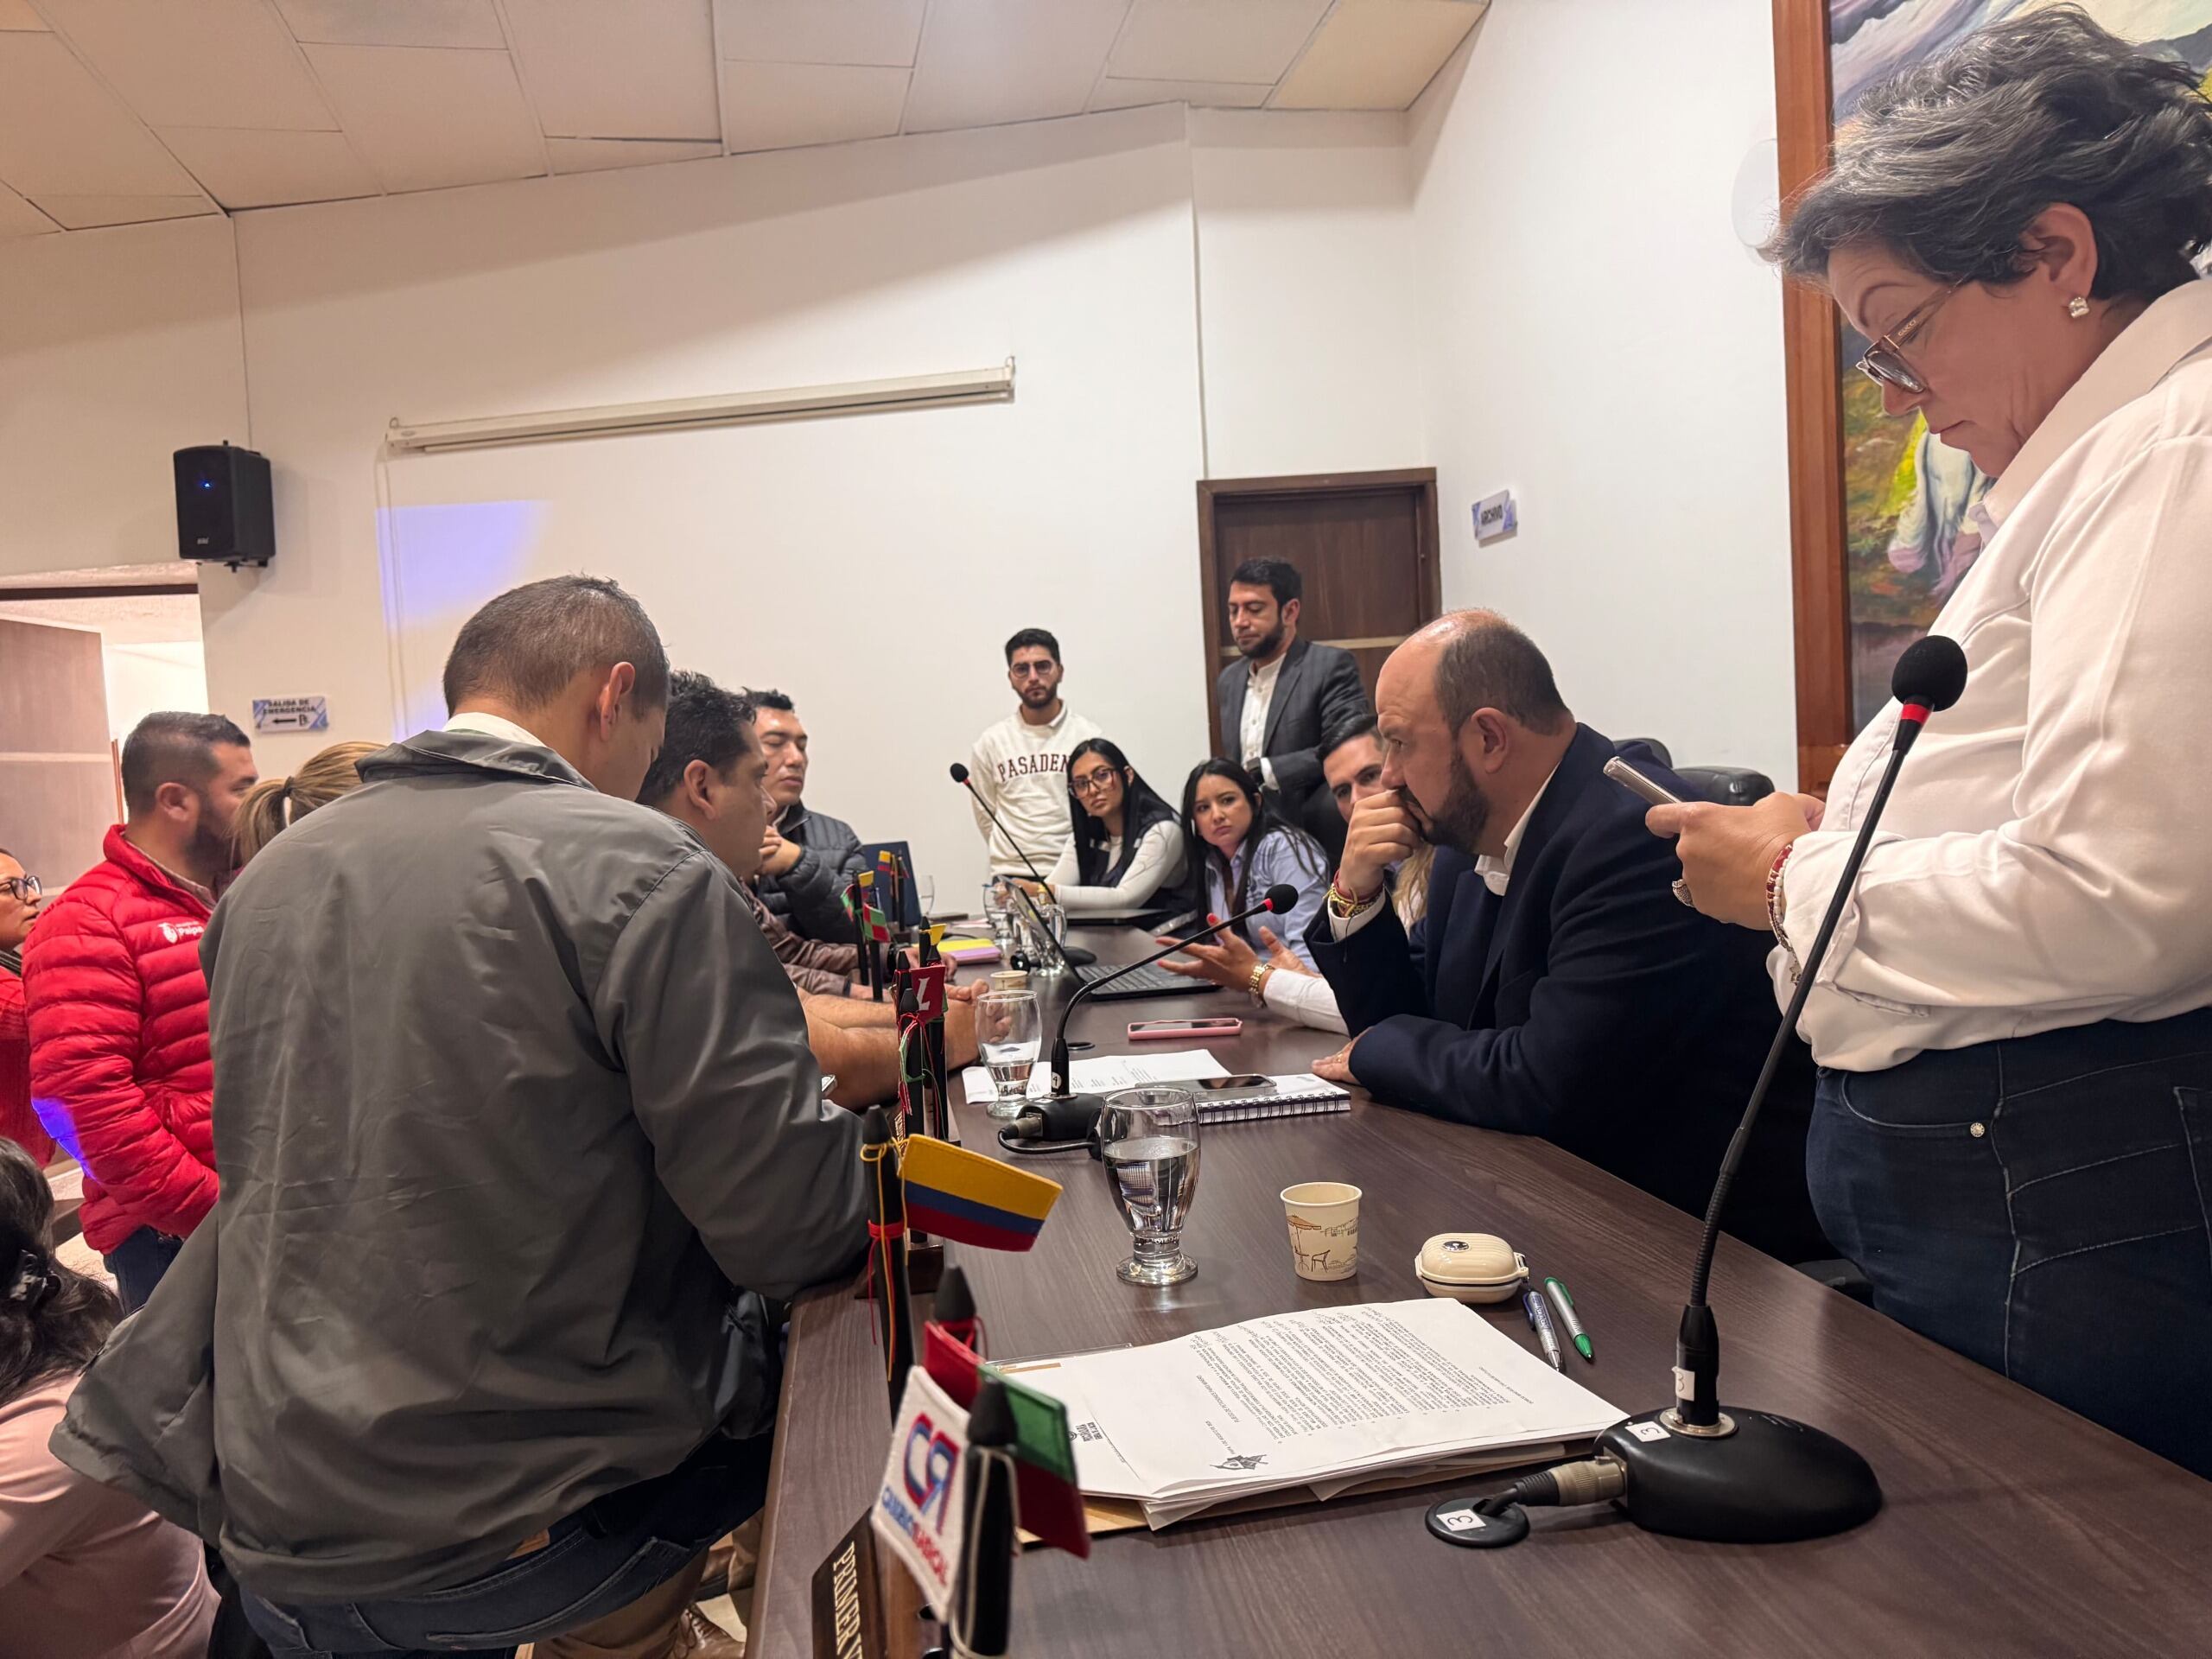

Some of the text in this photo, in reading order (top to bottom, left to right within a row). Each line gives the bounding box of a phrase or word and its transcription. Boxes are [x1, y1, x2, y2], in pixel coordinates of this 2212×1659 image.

[263, 706, 317, 715] EMERGENCIA
[916, 976, 931, 1011] L
[1446, 1515, 1473, 1526] 3
[832, 1541, 861, 1656] PRIMER
